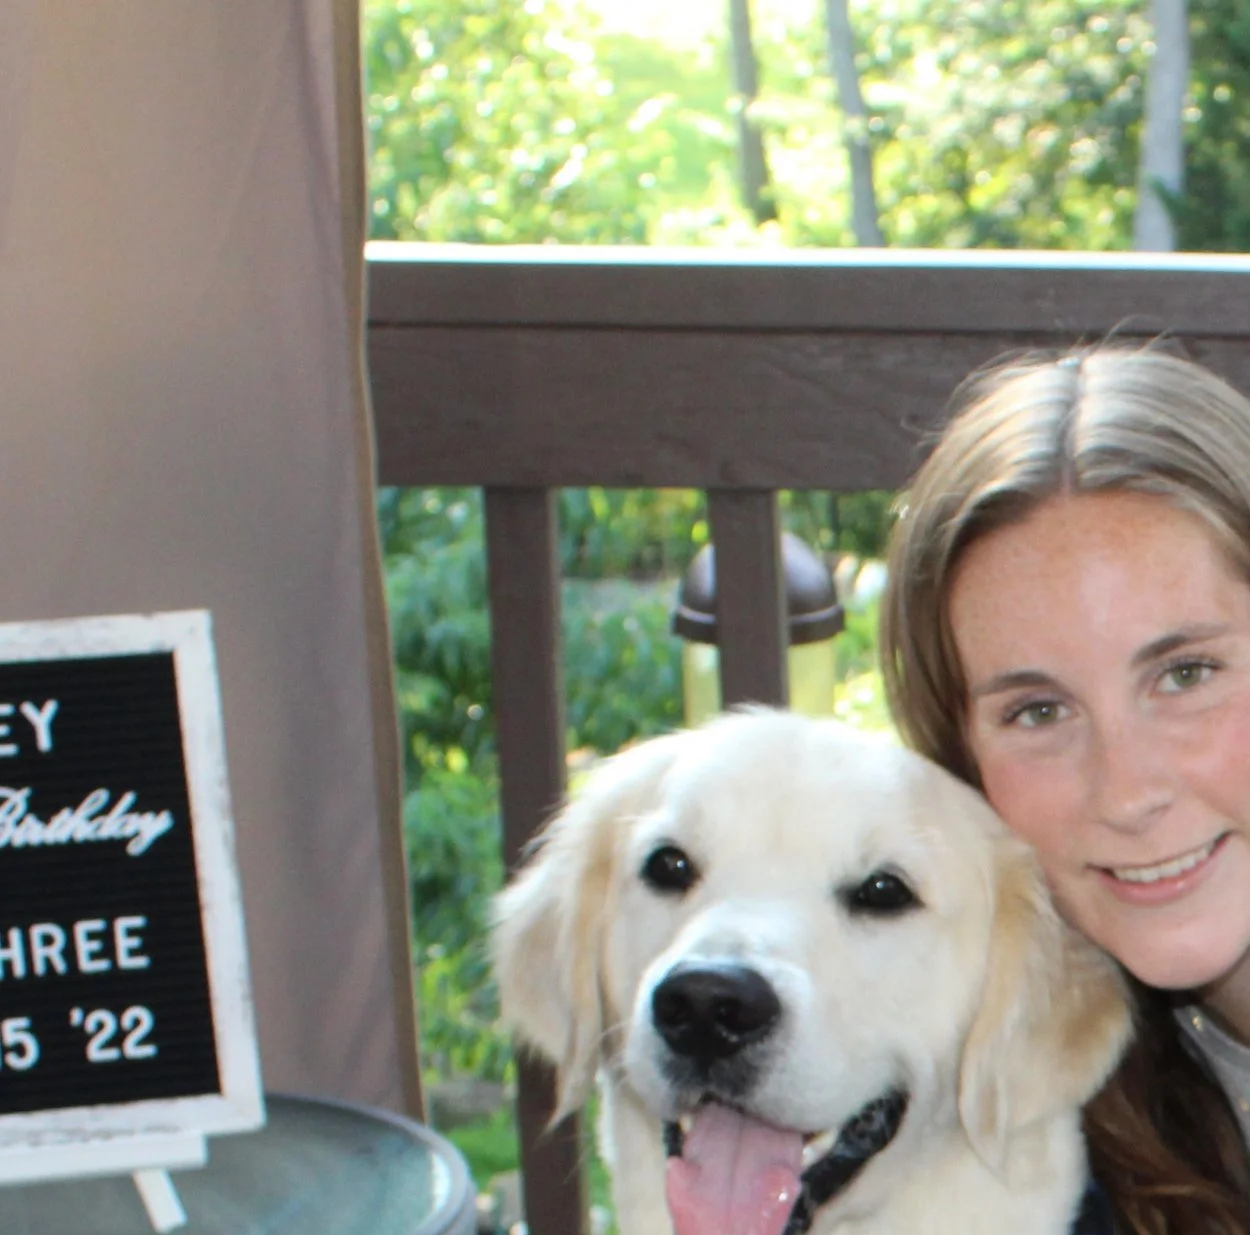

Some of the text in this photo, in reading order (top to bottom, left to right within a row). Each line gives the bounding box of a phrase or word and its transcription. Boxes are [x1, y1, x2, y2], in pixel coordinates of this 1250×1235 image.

[0, 787, 174, 857] Birthday
[0, 1004, 159, 1072] 5 '22
